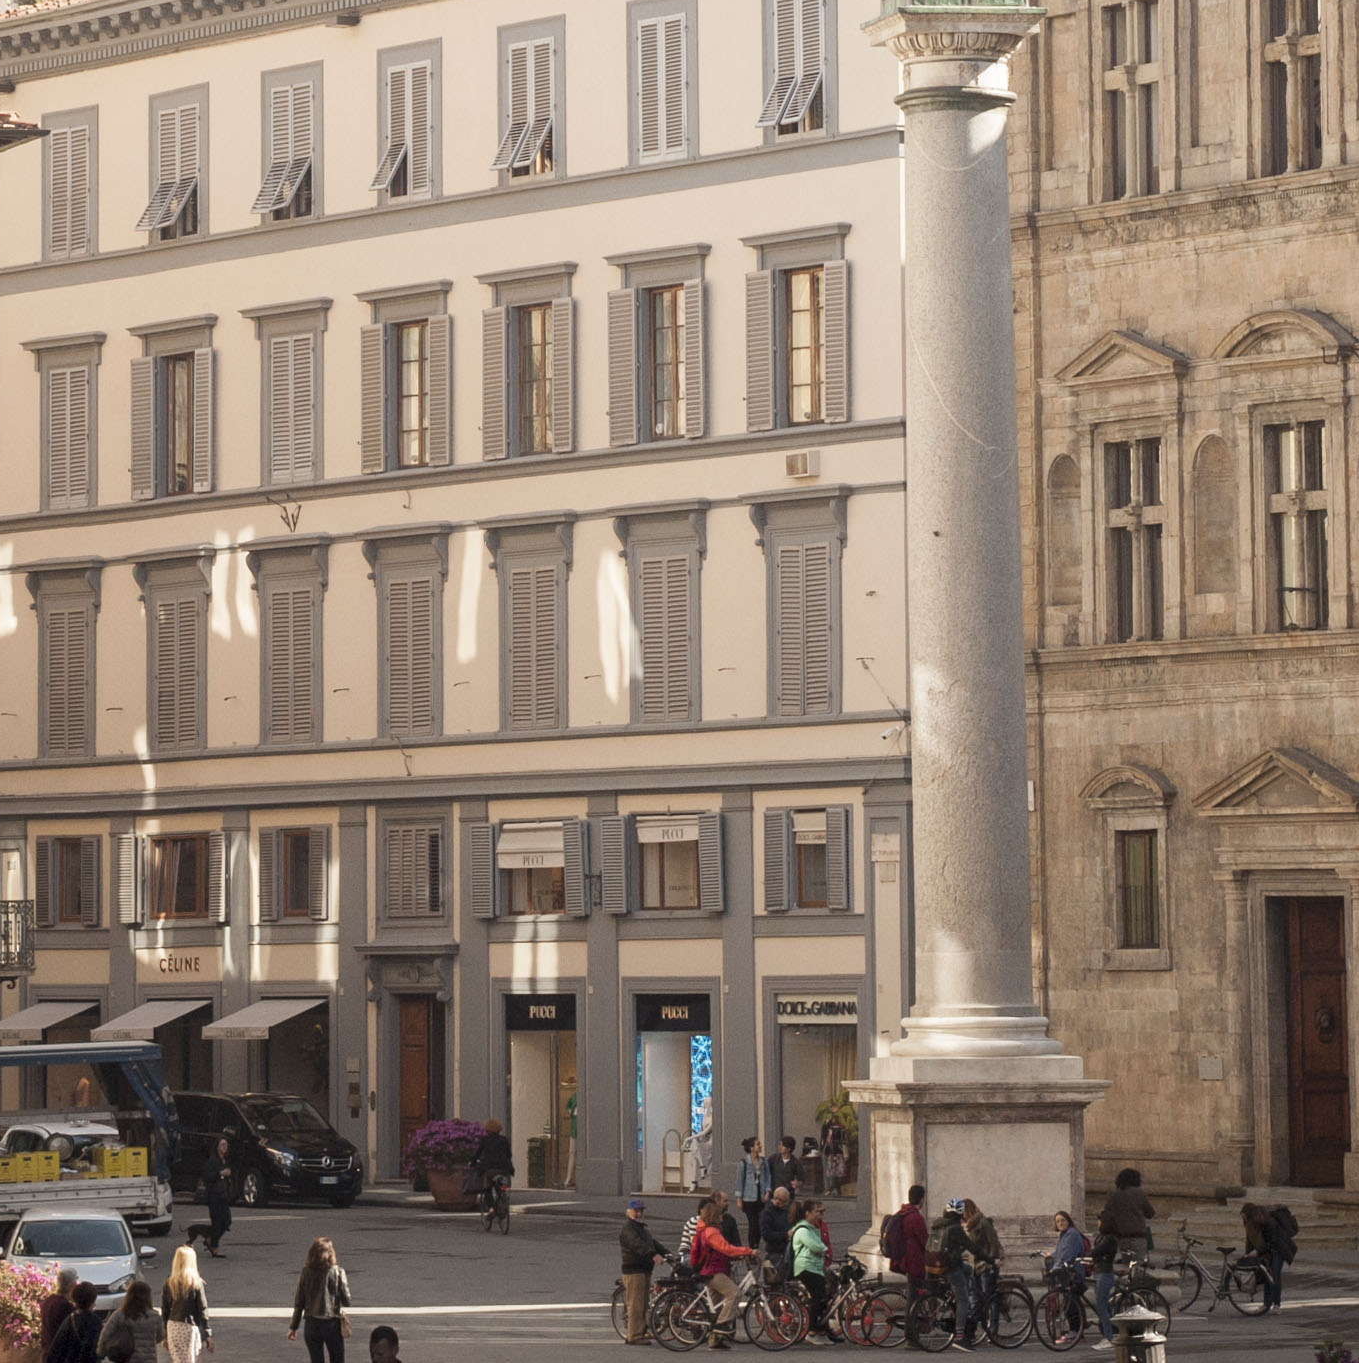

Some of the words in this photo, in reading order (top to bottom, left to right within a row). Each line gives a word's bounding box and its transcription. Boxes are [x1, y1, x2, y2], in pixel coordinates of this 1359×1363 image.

[662, 828, 684, 840] PUCCI
[522, 854, 545, 866] PUCCI
[159, 953, 201, 973] CÉLINE
[529, 1005, 557, 1019] PUCCI
[661, 1005, 689, 1020] PUCCI
